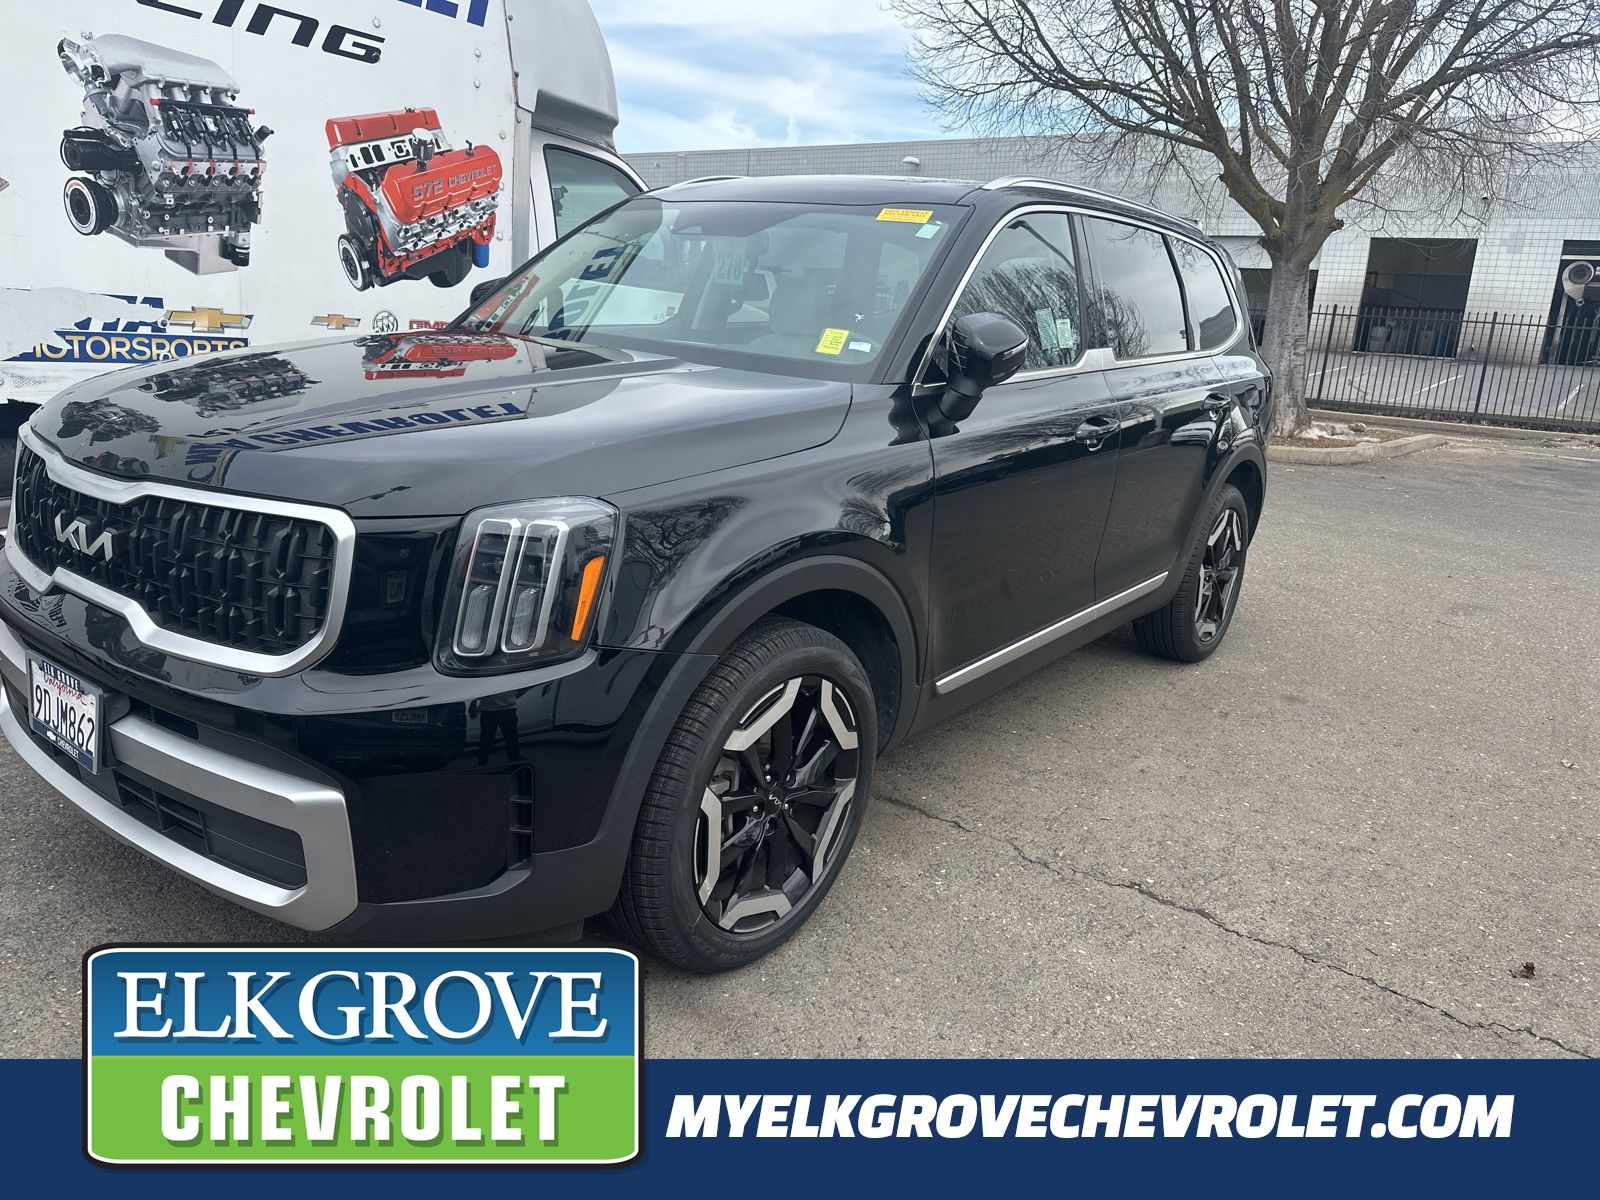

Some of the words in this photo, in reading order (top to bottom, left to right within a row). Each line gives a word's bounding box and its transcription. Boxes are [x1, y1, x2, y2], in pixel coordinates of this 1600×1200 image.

[412, 178, 443, 201] 572
[448, 164, 496, 188] CHEVROLET
[54, 512, 113, 562] KIA
[43, 661, 56, 678] ELK
[57, 671, 80, 691] GROVE
[34, 683, 95, 757] 9DJM862
[57, 737, 80, 760] CHEVROLET
